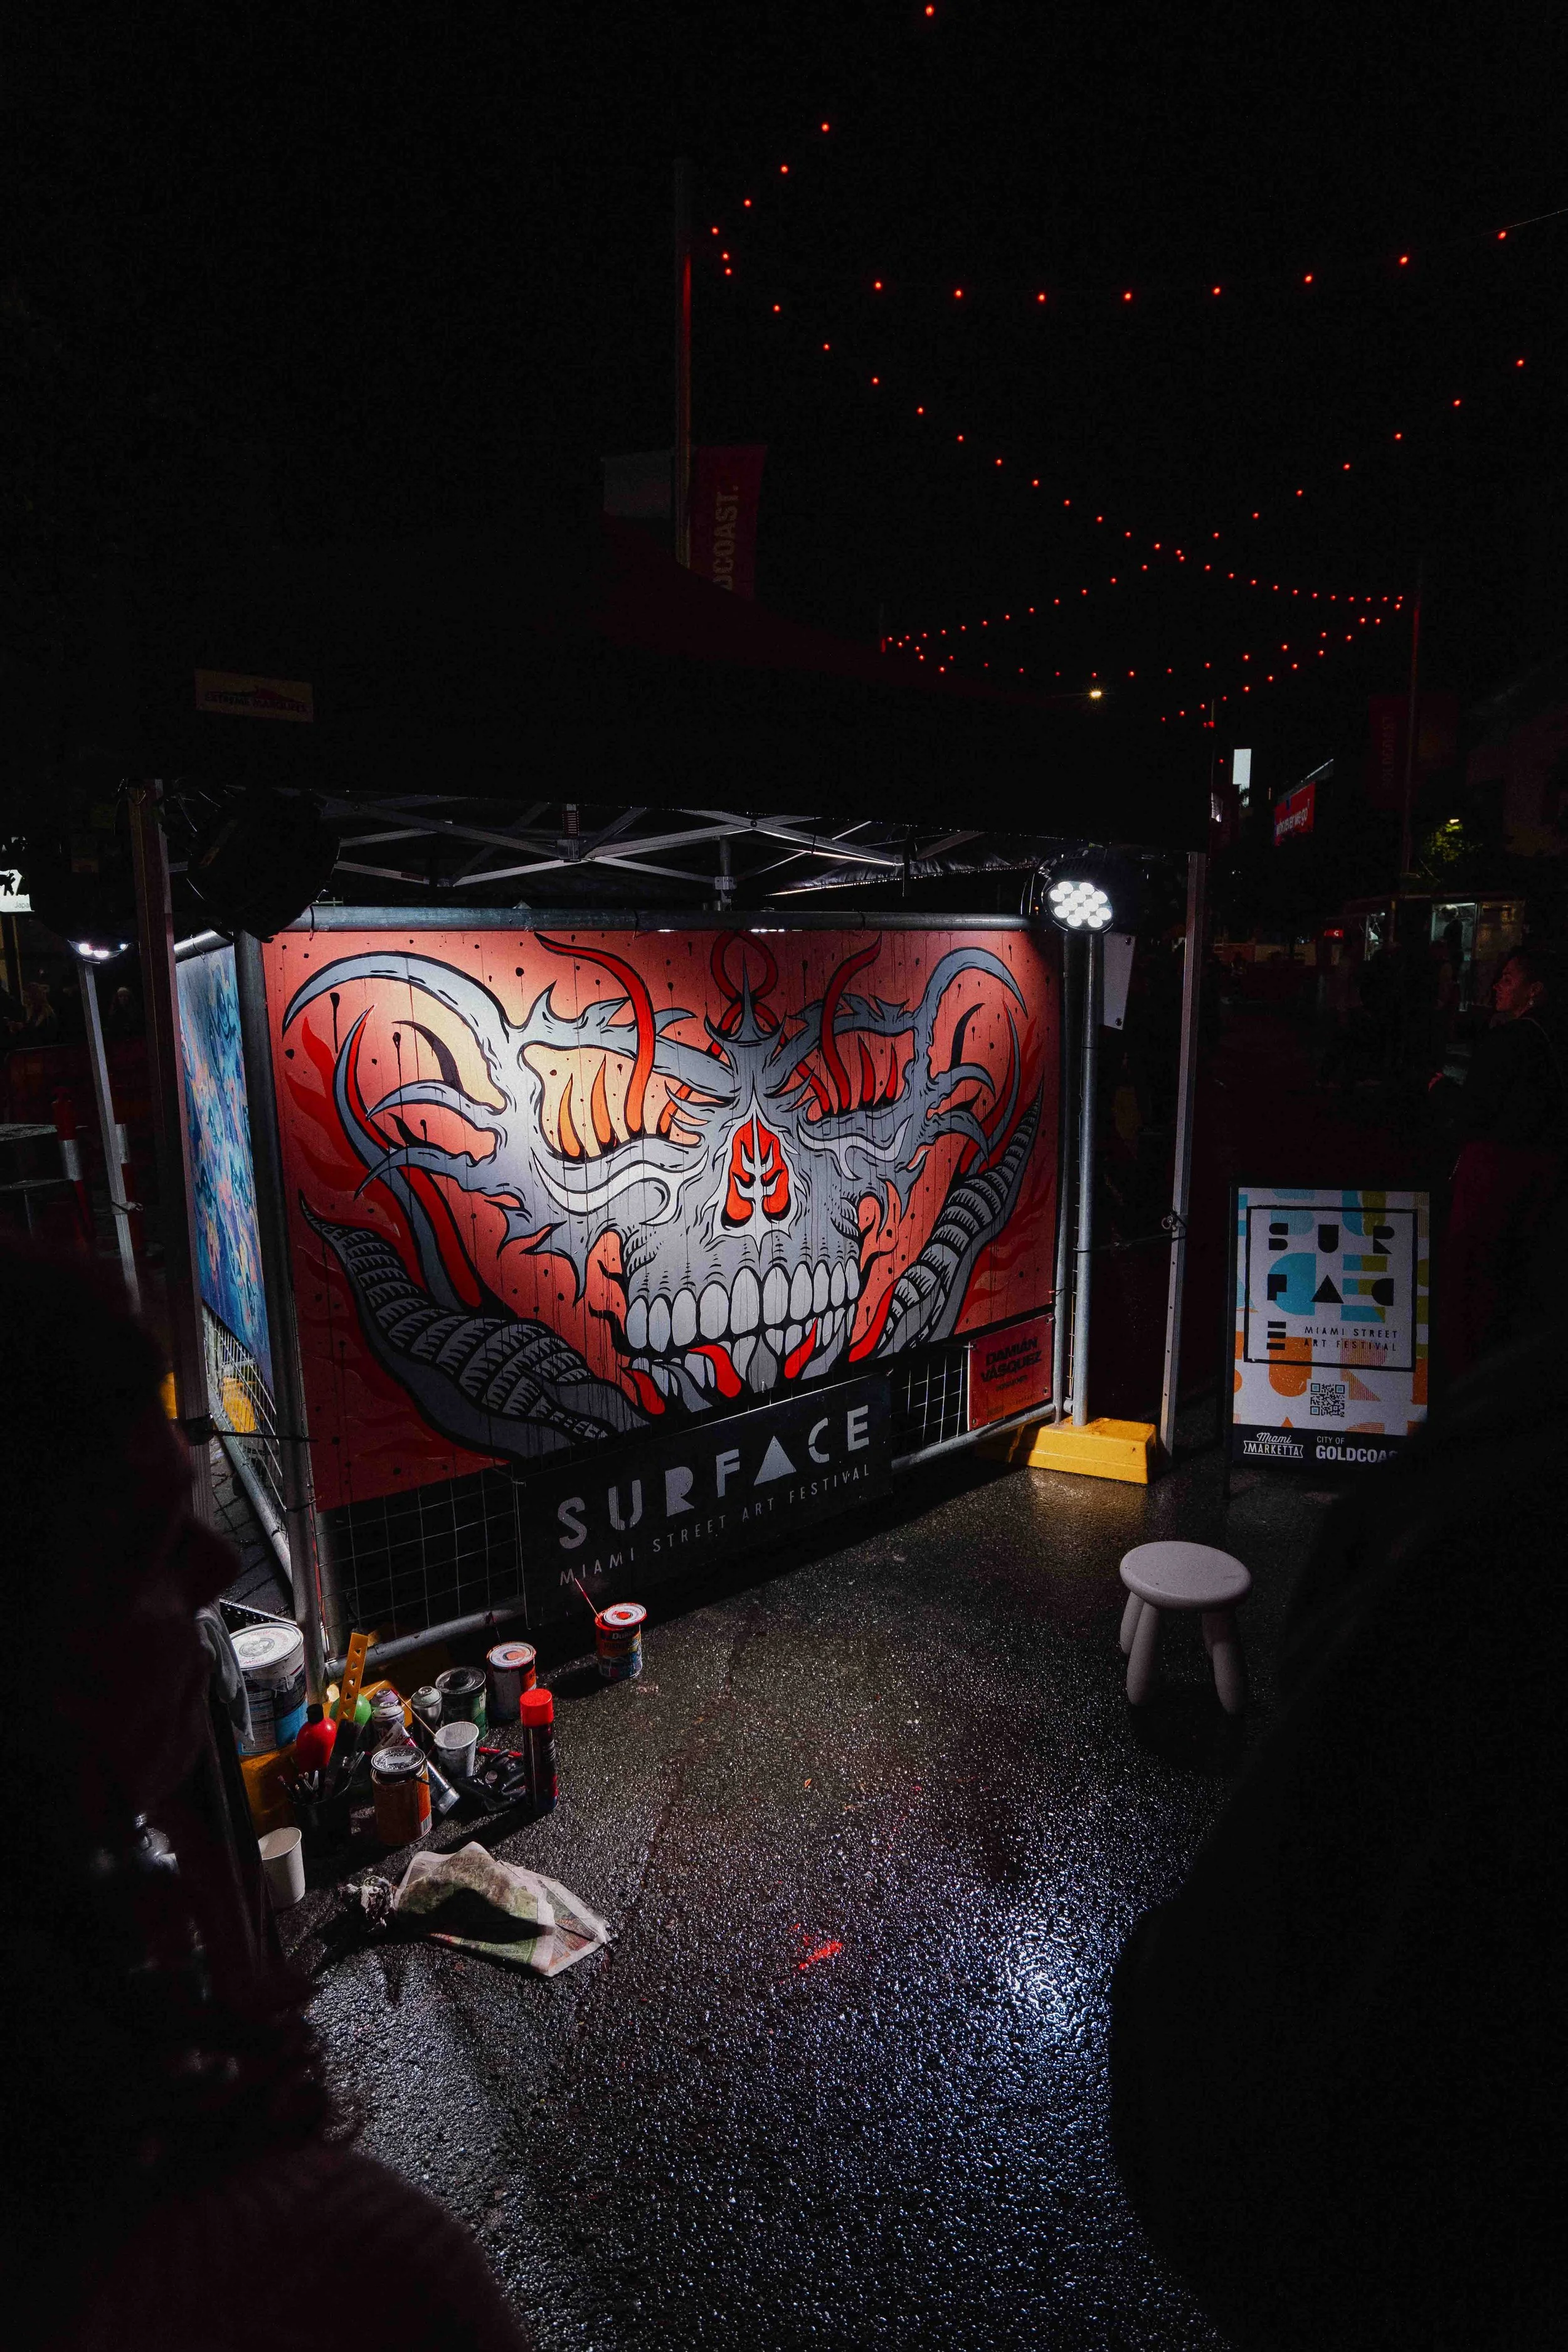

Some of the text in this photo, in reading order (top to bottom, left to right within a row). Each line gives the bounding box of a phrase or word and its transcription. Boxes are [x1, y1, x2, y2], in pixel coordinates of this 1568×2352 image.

[1305, 1326, 1397, 1338] MIAMI STREET
[1304, 1338, 1396, 1351] ART FESTIVAL
[1256, 1432, 1292, 1444] Miami
[1248, 1442, 1299, 1456] MARKETTA
[557, 1404, 870, 1549] SURFACE
[559, 1463, 871, 1586] MIAMI STREET ART FESTIVAL
